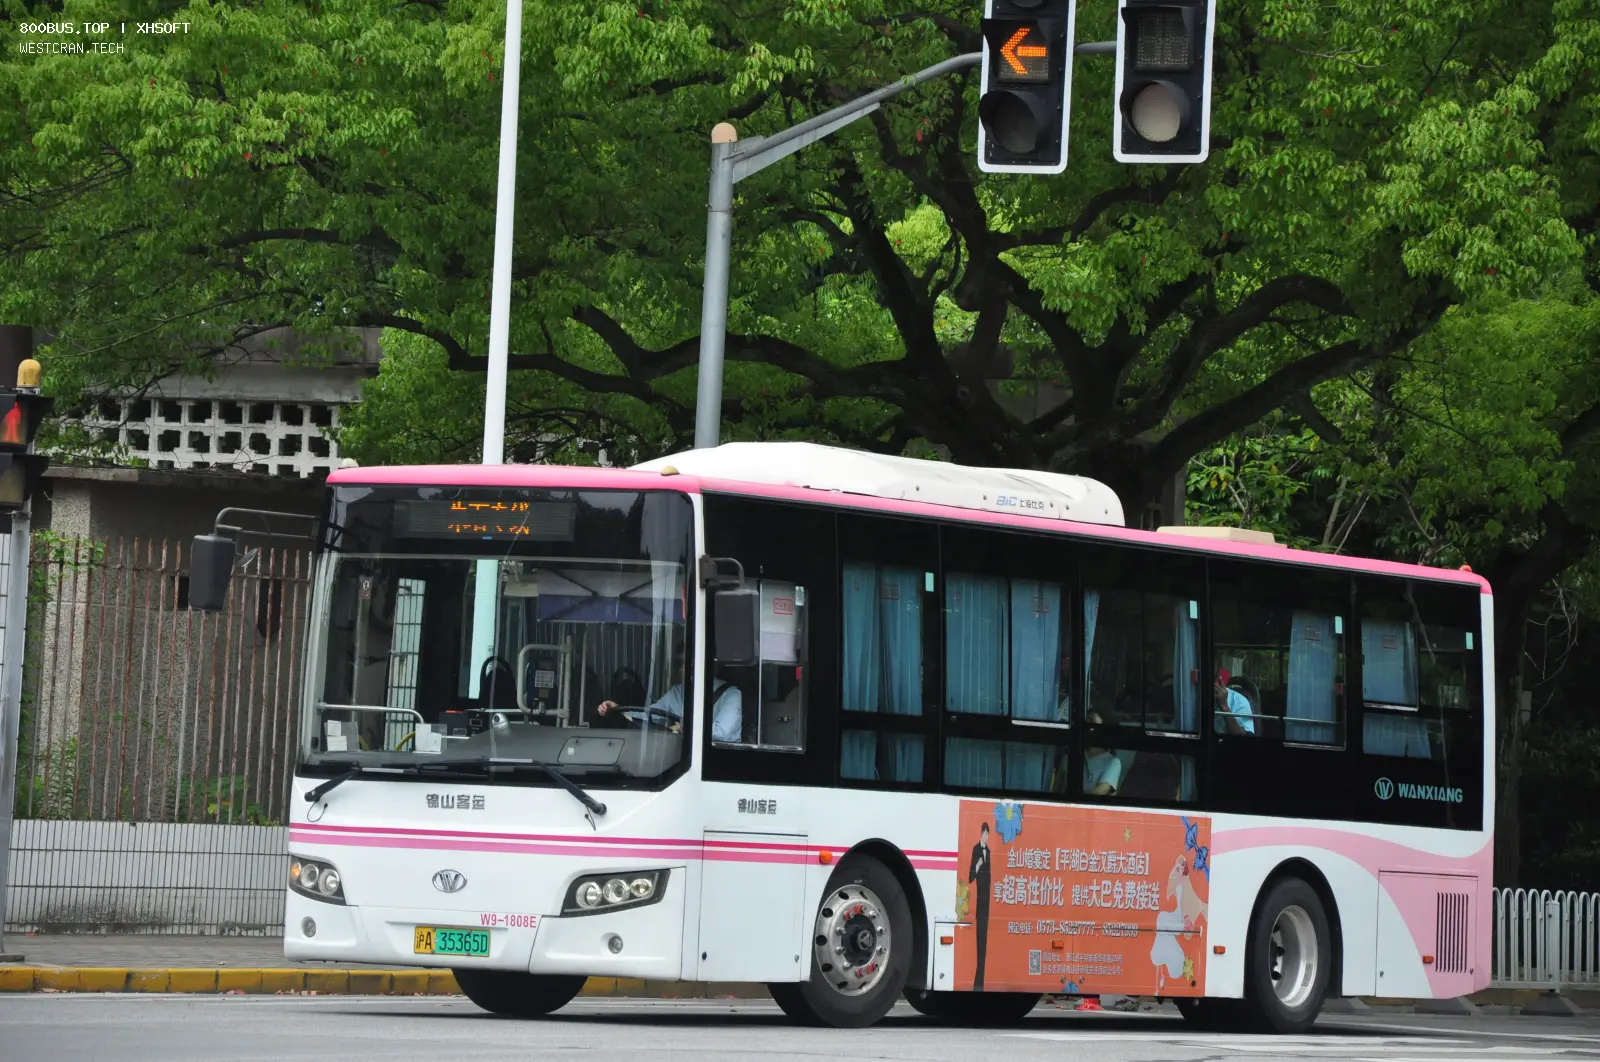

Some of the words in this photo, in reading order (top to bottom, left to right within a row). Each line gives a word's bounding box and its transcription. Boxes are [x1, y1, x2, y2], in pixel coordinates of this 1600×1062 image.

[1020, 498, 1045, 510] 上海比克
[1398, 783, 1463, 803] WANXIANG
[480, 913, 537, 928] W9-1808E
[416, 931, 432, 950] 沪A
[439, 932, 488, 953] 35365D
